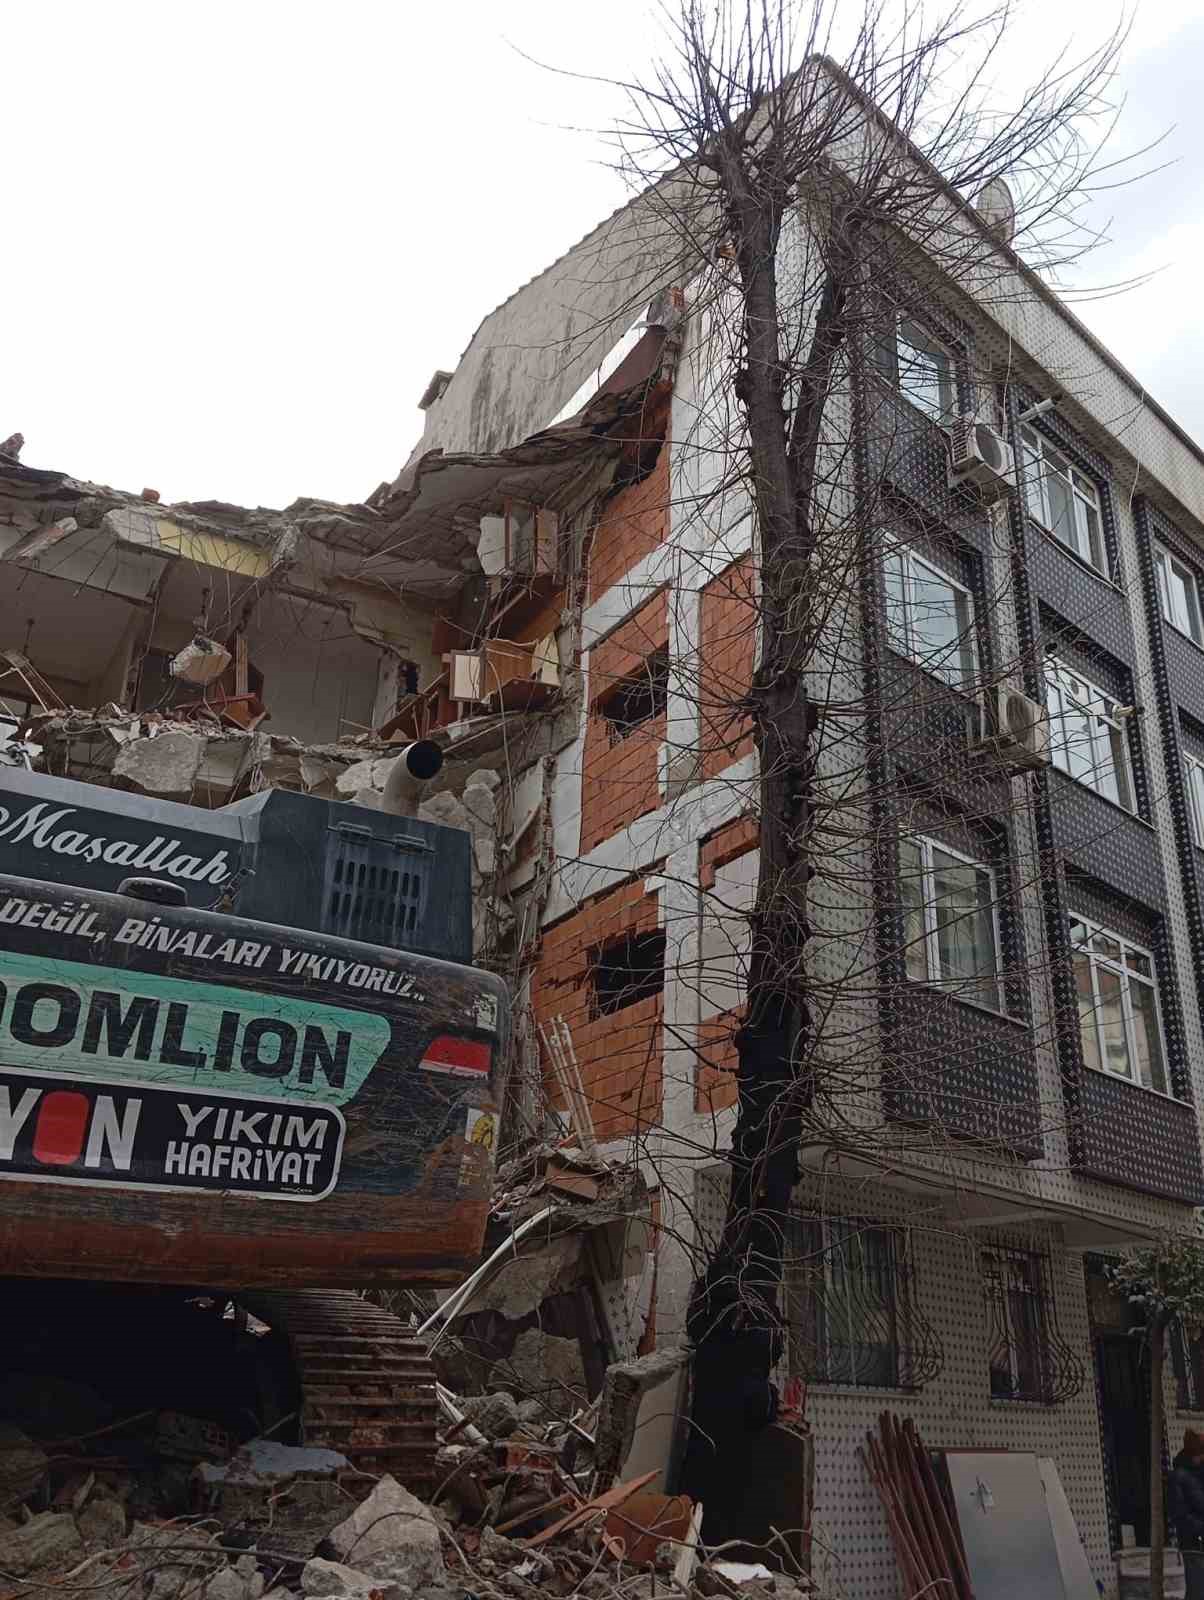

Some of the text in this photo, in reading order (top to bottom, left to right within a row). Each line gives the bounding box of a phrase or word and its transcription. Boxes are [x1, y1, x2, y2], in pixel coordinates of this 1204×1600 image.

[0, 802, 231, 885] Maşallah
[113, 917, 271, 968] BİNALARI
[0, 979, 352, 1089] OMLION
[177, 1103, 329, 1150] YIKIM
